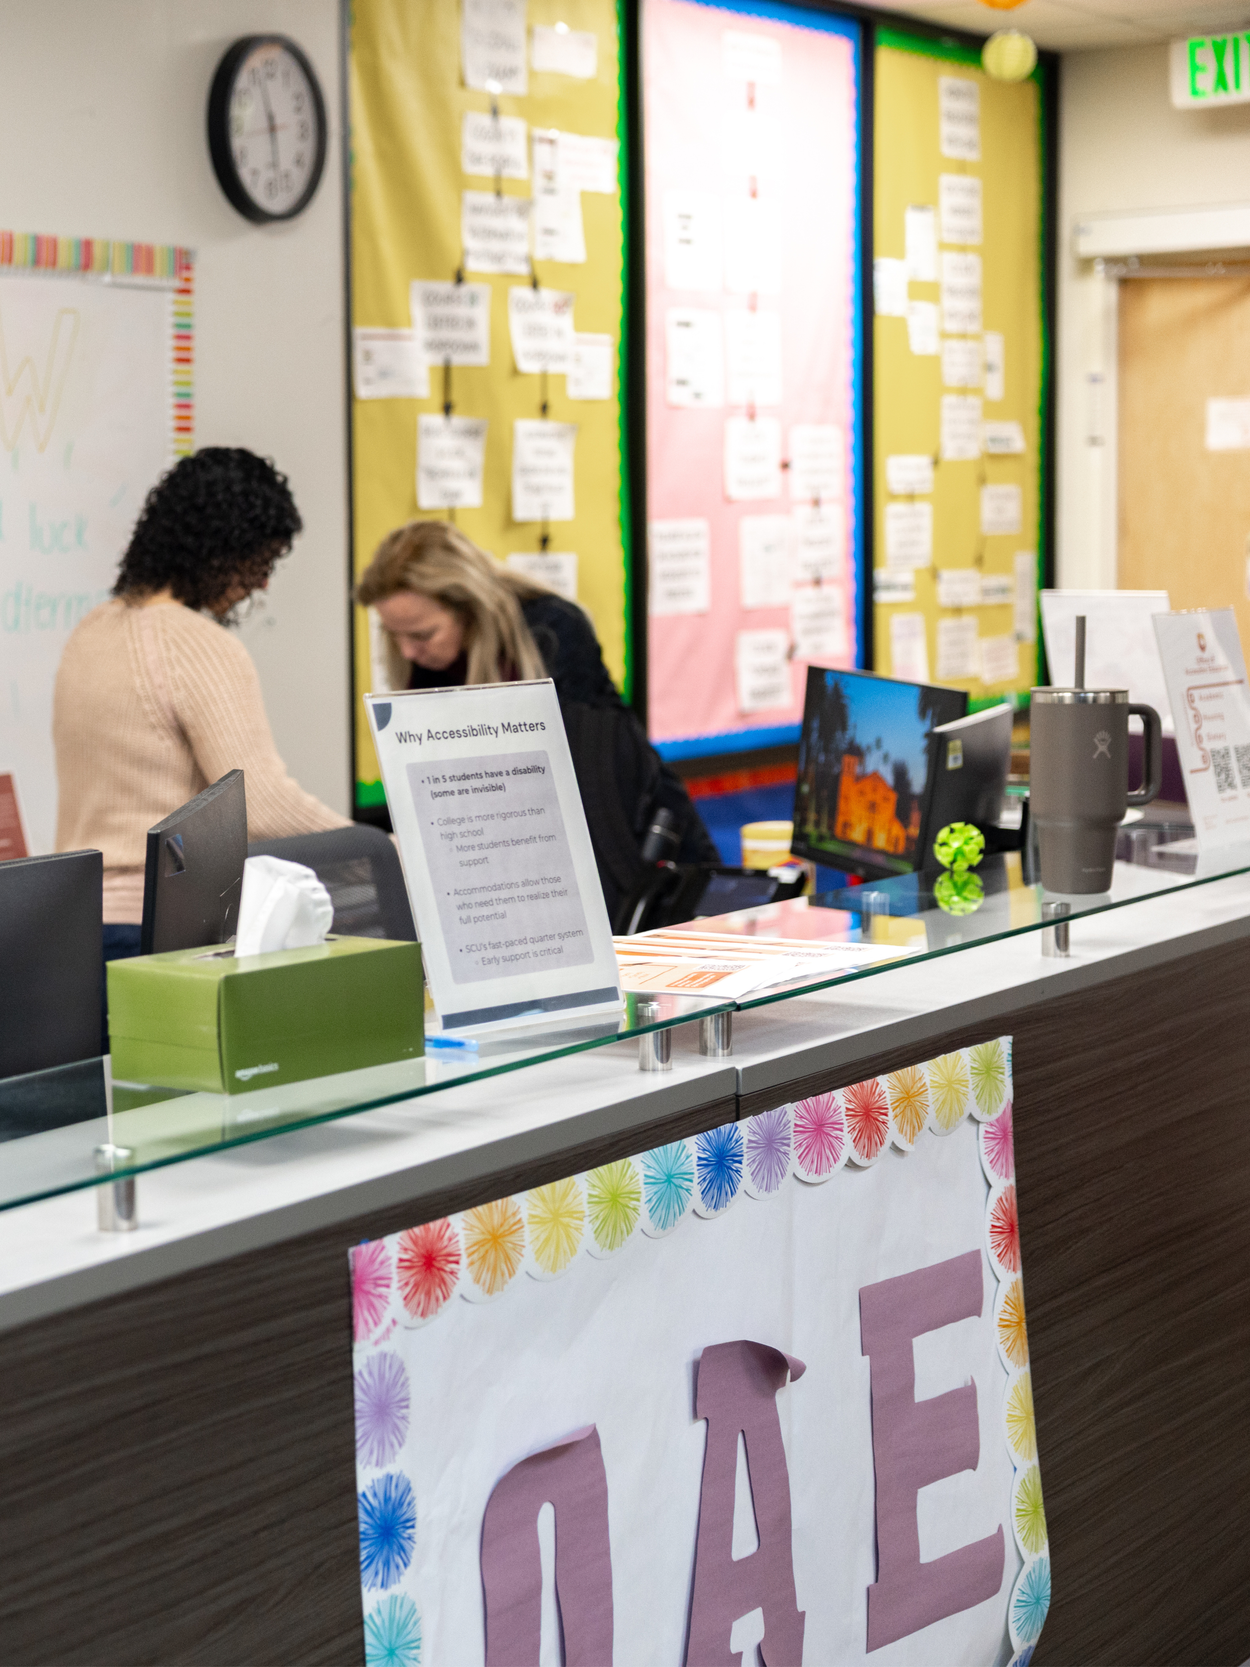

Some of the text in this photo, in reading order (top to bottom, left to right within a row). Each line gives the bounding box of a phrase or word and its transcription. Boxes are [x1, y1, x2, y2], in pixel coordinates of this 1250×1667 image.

[1187, 32, 1250, 100] EXI
[28, 501, 89, 555] luck
[395, 721, 546, 745] Why Accessibility Matters
[432, 776, 440, 784] in
[442, 774, 447, 783] 5
[449, 771, 483, 782] students
[484, 770, 504, 779] have
[511, 765, 546, 776] disability
[430, 783, 506, 799] (some are invisible)
[437, 807, 545, 826] College is more rigorous than
[440, 827, 484, 841] high school
[456, 834, 556, 853] More students benefit from
[459, 856, 489, 868] support
[453, 876, 561, 896] Accommodations allow those
[456, 901, 473, 911] who
[475, 898, 494, 908] need
[495, 896, 516, 905] them
[526, 891, 550, 901] realize
[551, 888, 568, 897] their
[459, 910, 507, 925] full potential
[465, 929, 584, 953] SCU's fast-paced quarter system
[481, 945, 564, 965] Early support is critical
[479, 1249, 1006, 1667] OAE
